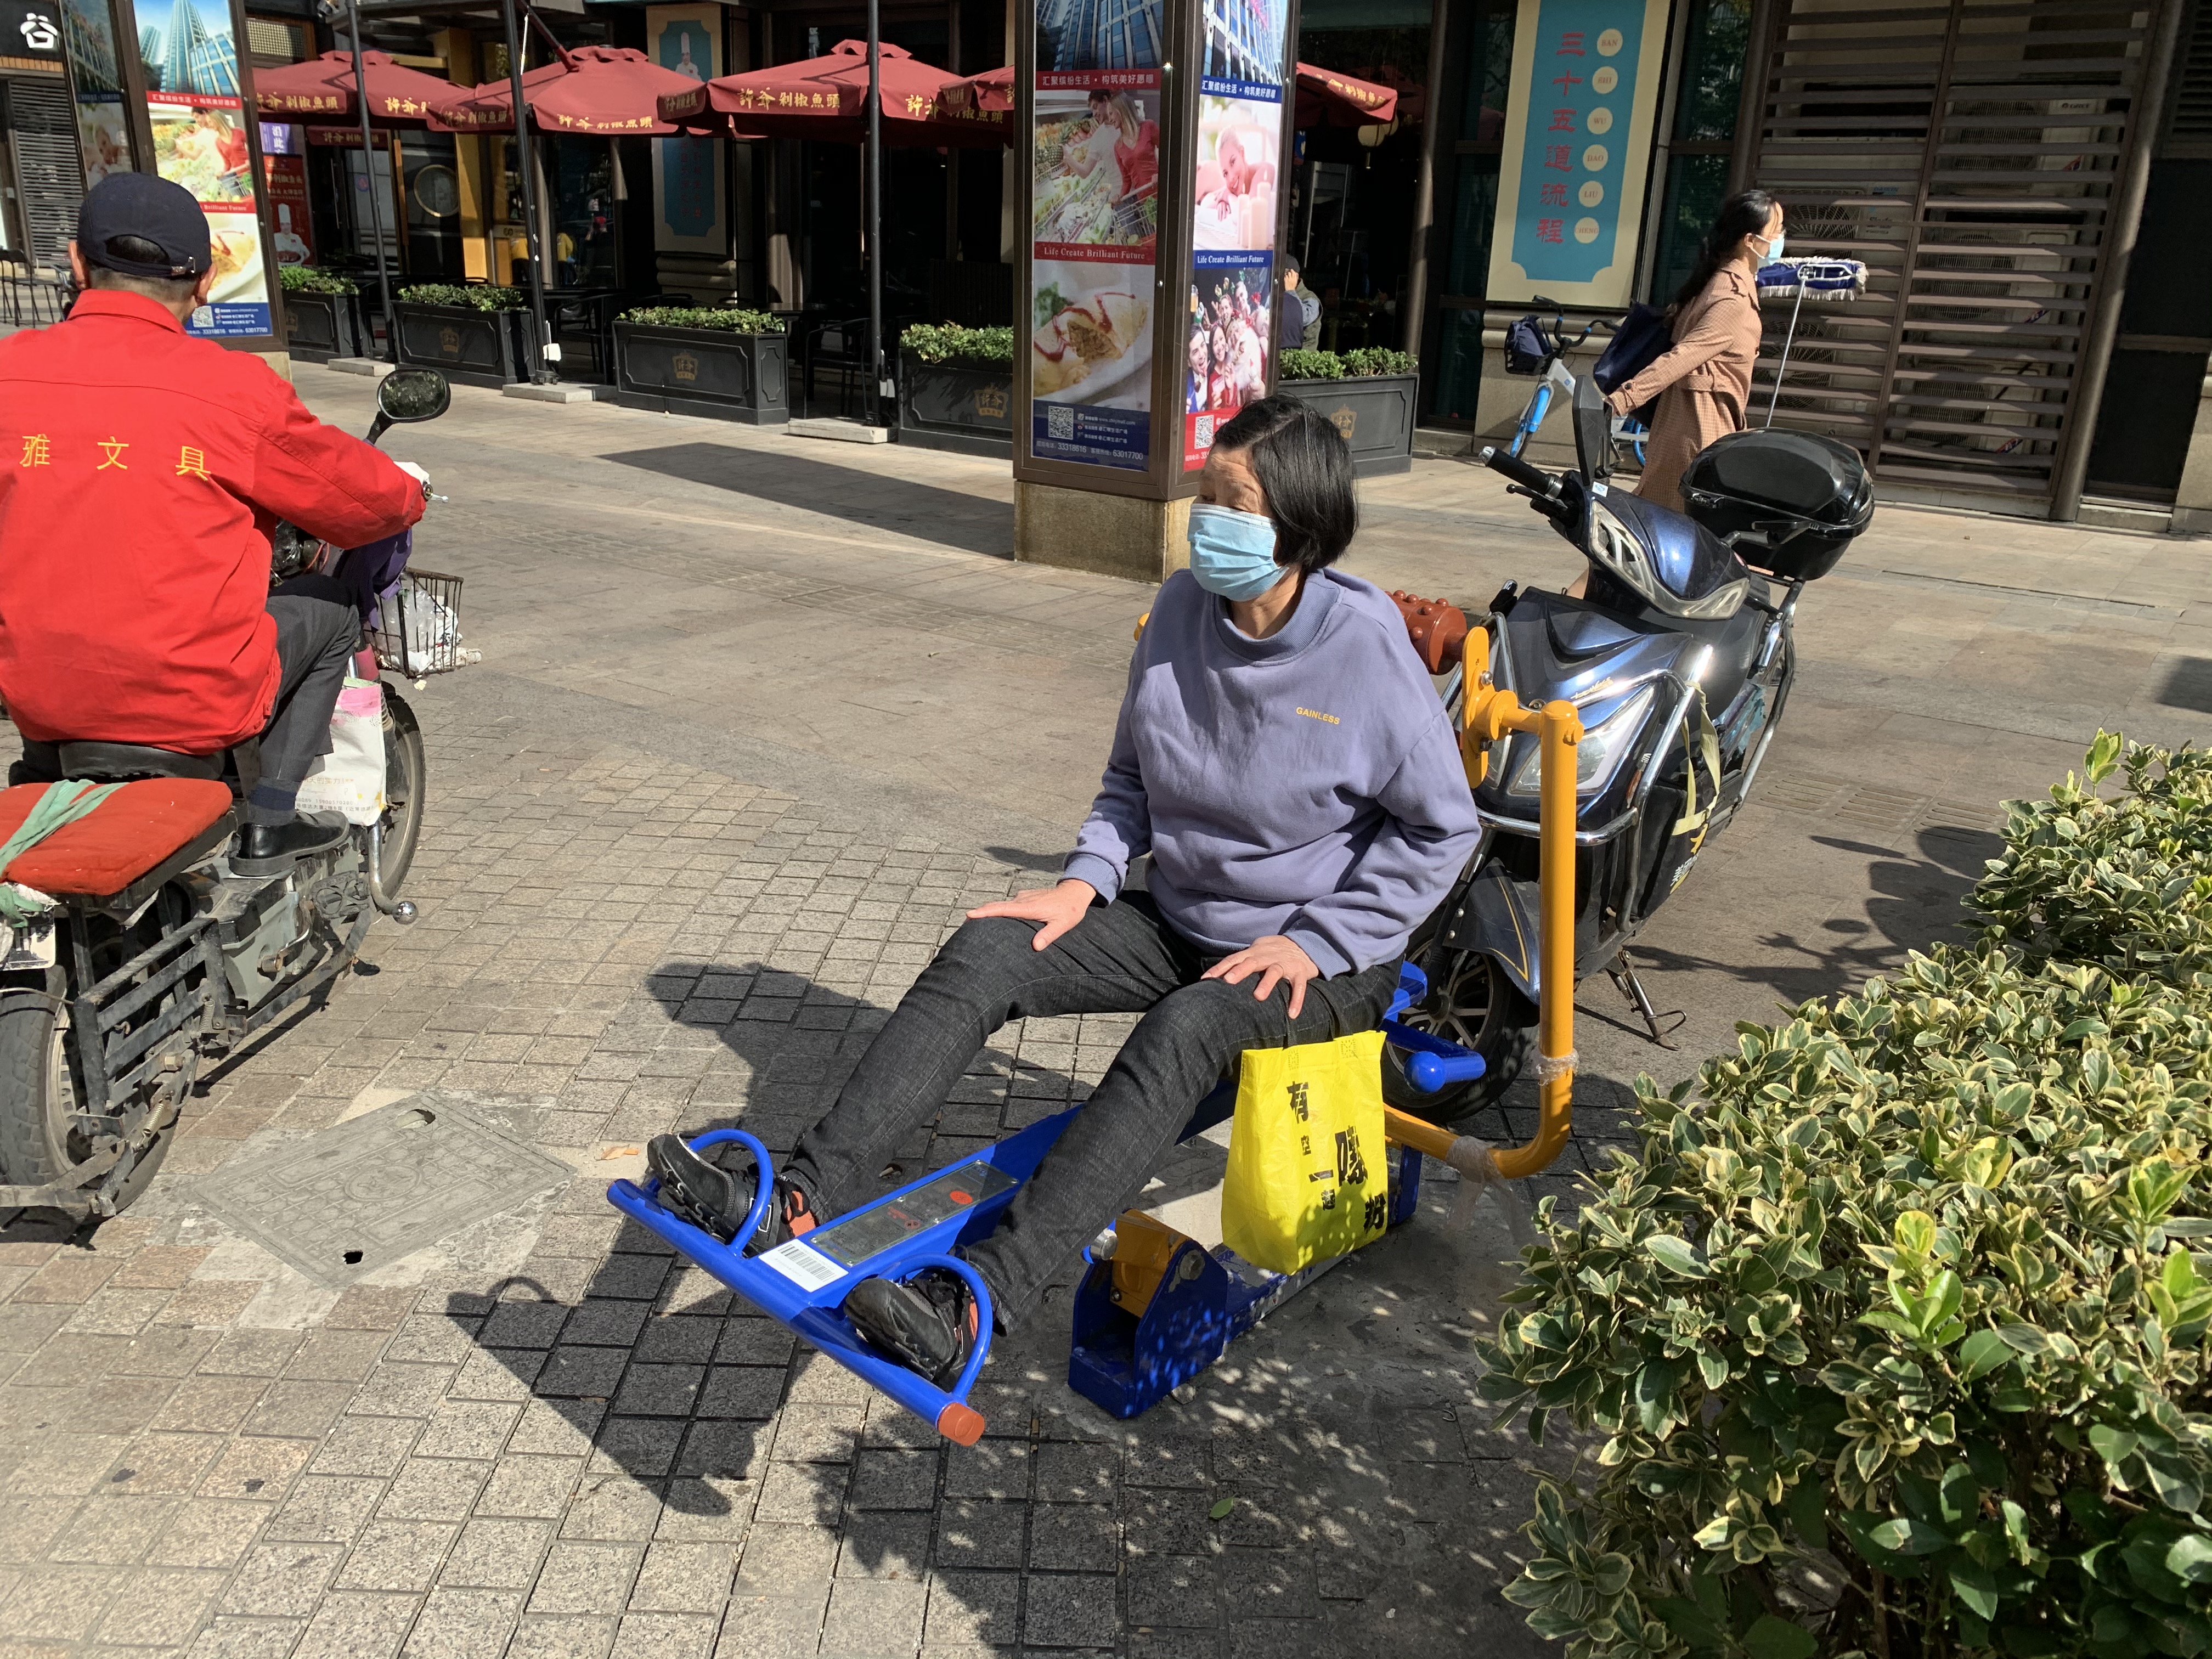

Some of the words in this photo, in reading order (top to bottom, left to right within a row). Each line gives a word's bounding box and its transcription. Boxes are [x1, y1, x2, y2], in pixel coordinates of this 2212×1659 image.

[1536, 32, 1585, 244] 三十五道流程
[1044, 247, 1058, 256] Life
[1061, 248, 1084, 257] Create
[1087, 249, 1119, 258] Brilliant
[1121, 251, 1145, 259] Future
[1197, 255, 1207, 264] Life
[1208, 255, 1224, 263] Create
[1226, 255, 1248, 263] Brilliant
[1296, 707, 1340, 725] GAINLESS
